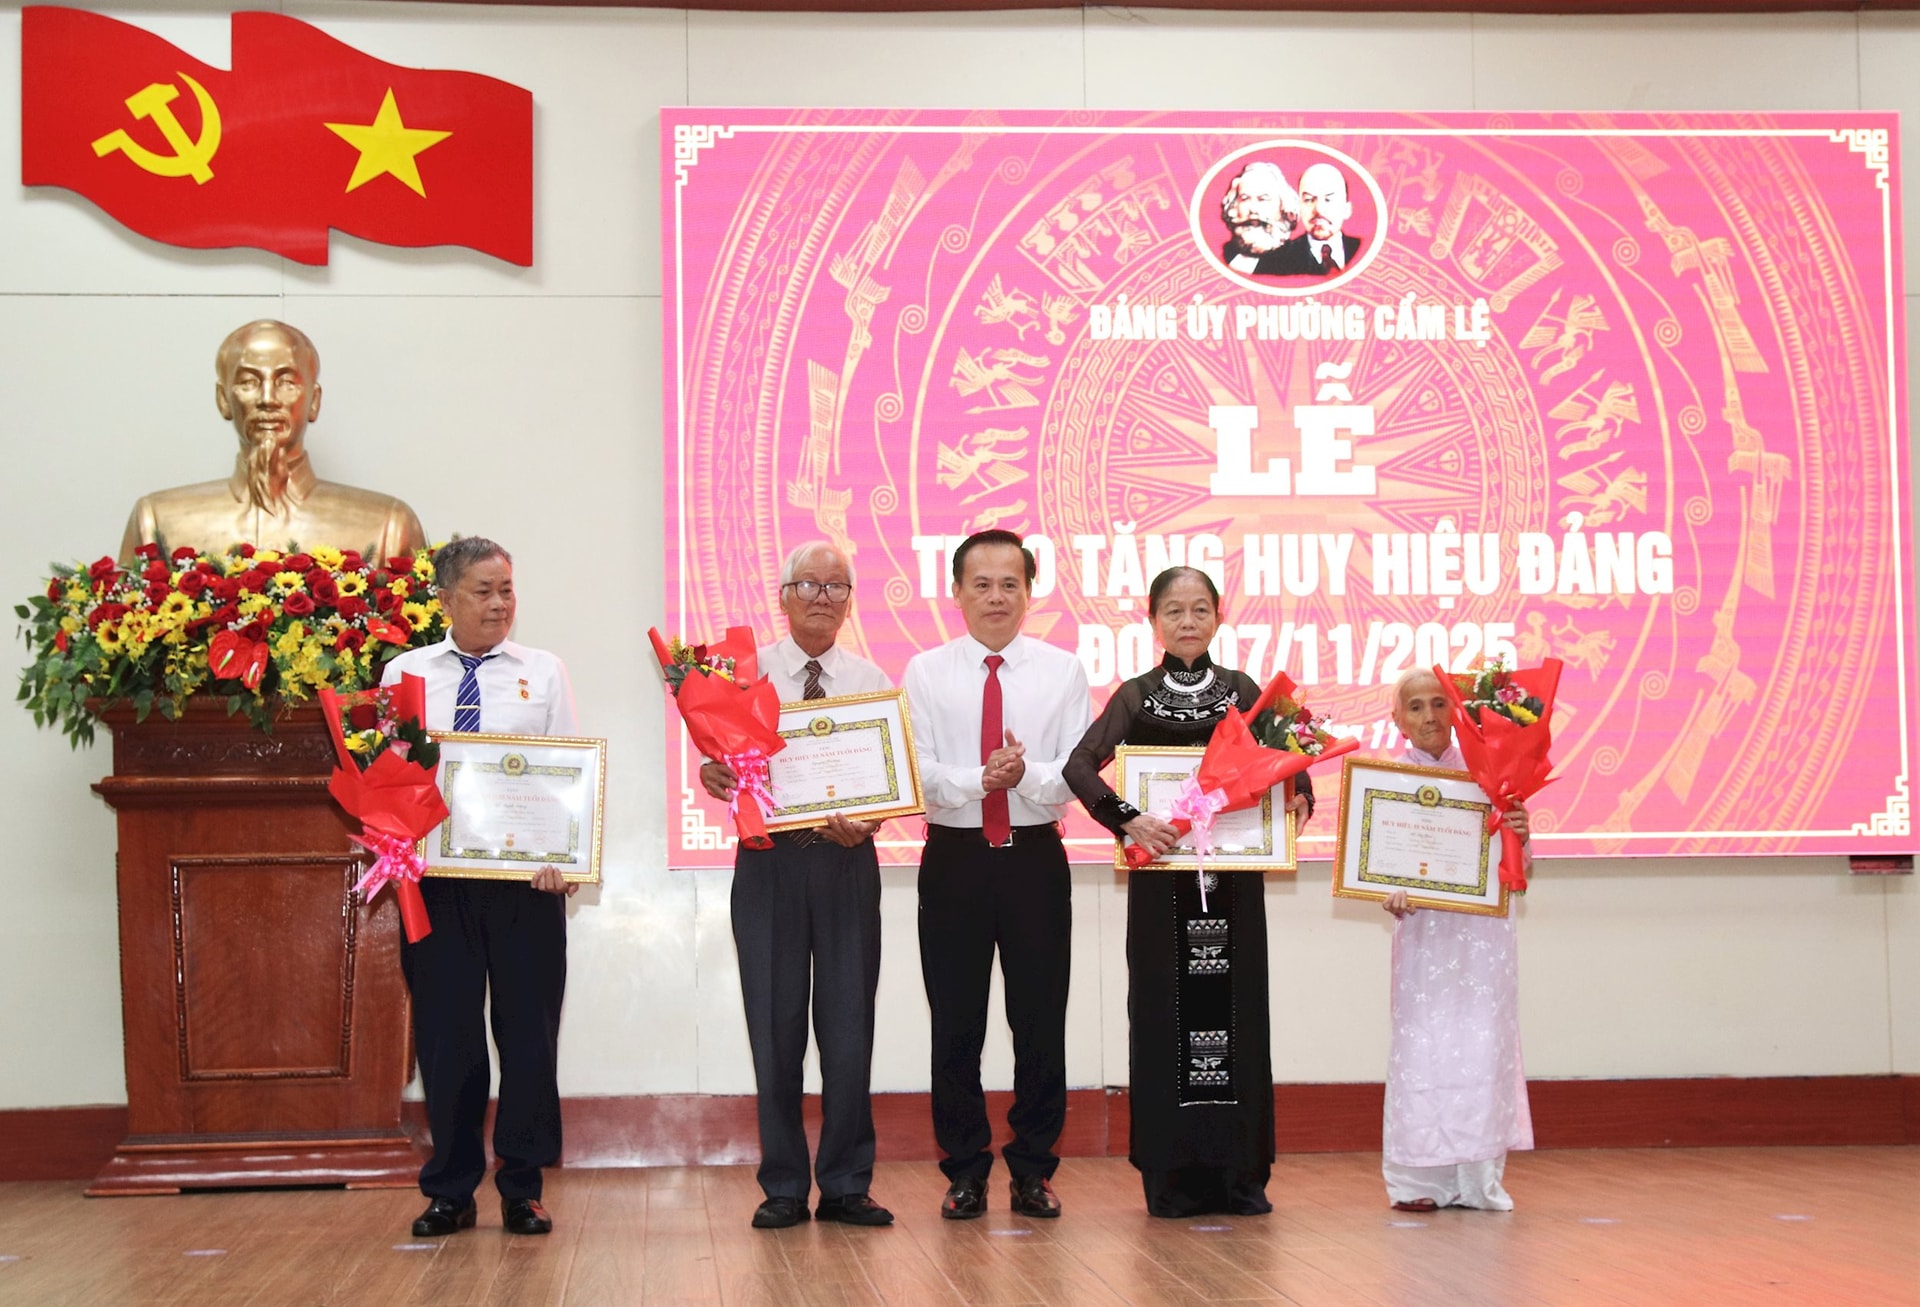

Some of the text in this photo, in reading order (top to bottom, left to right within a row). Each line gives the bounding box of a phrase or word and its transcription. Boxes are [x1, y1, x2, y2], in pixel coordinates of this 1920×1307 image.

[1090, 293, 1178, 340] ĐẢNG
[1187, 293, 1228, 340] ỦY
[1236, 297, 1365, 340] PHƯỜNG
[1455, 298, 1491, 347] LỆ
[1208, 361, 1377, 496] LỄ
[911, 511, 1674, 611] TO TẶNG HUY HIỆU ĐẢNG
[1208, 620, 1518, 687] 07/11/2025
